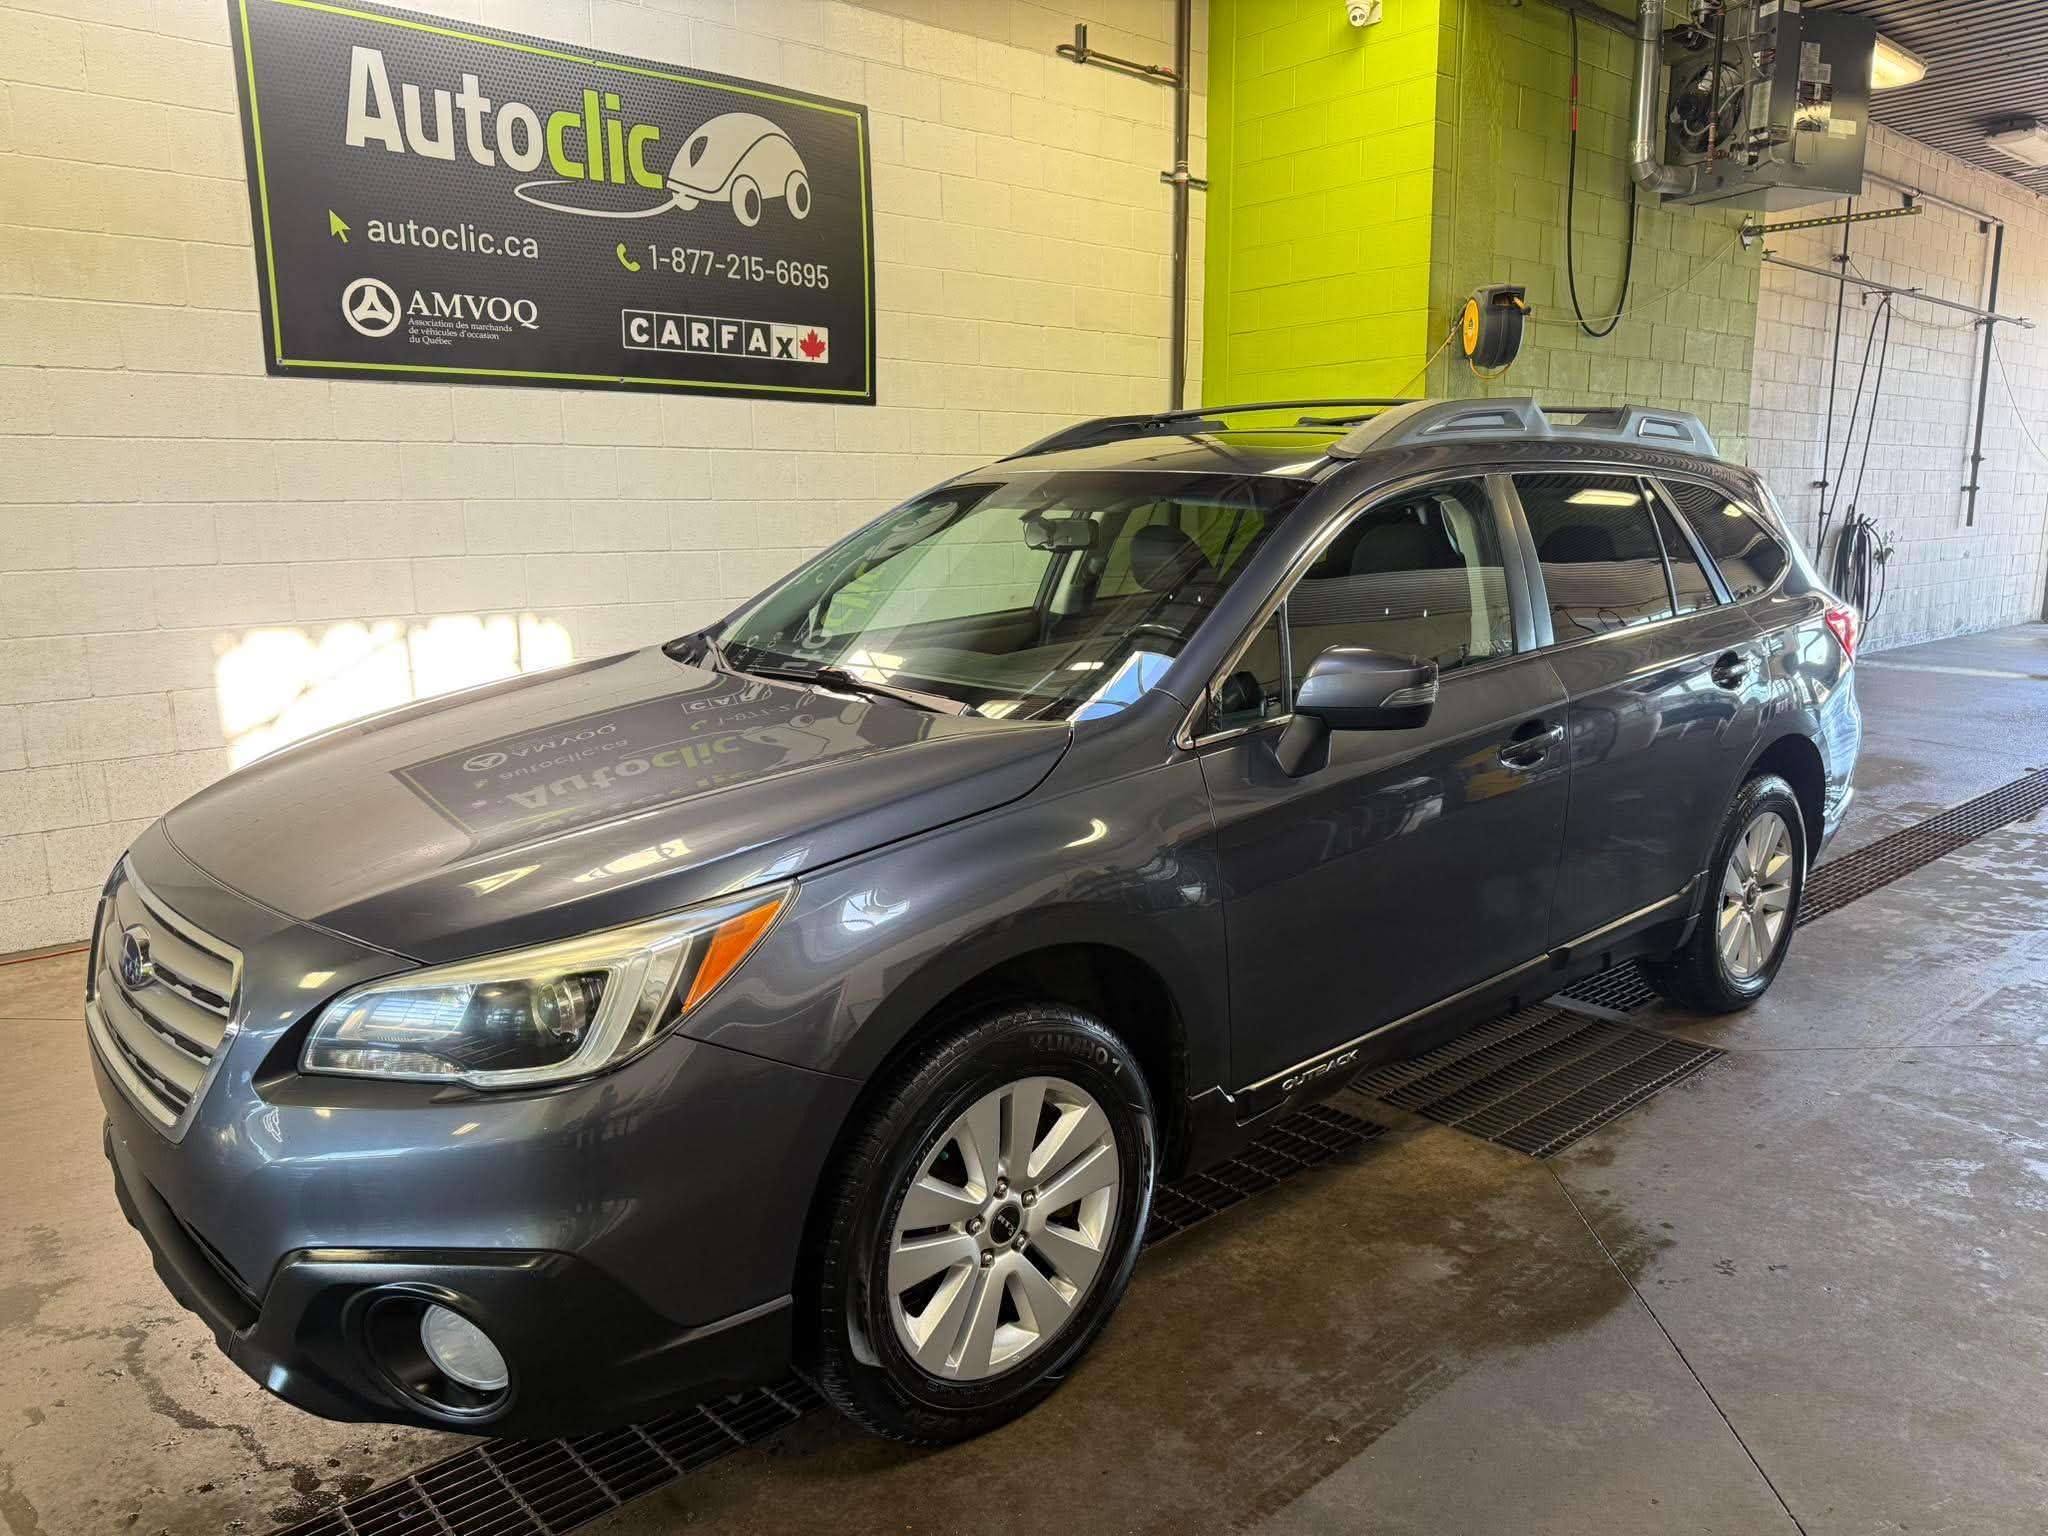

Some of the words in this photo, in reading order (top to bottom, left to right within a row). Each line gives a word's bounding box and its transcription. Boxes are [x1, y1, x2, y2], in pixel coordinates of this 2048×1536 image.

[345, 45, 664, 190] Autoclic
[367, 219, 539, 259] autoclic.ca
[648, 244, 829, 289] 1-877-215-6695
[406, 289, 540, 330] AMVOQ
[407, 317, 454, 329] Association
[455, 320, 469, 330] des
[470, 323, 513, 332] marchands
[408, 327, 419, 335] de
[420, 327, 458, 337] véhicules
[409, 336, 421, 344] du
[422, 335, 453, 346] Québec
[629, 316, 794, 360] CARFAX
